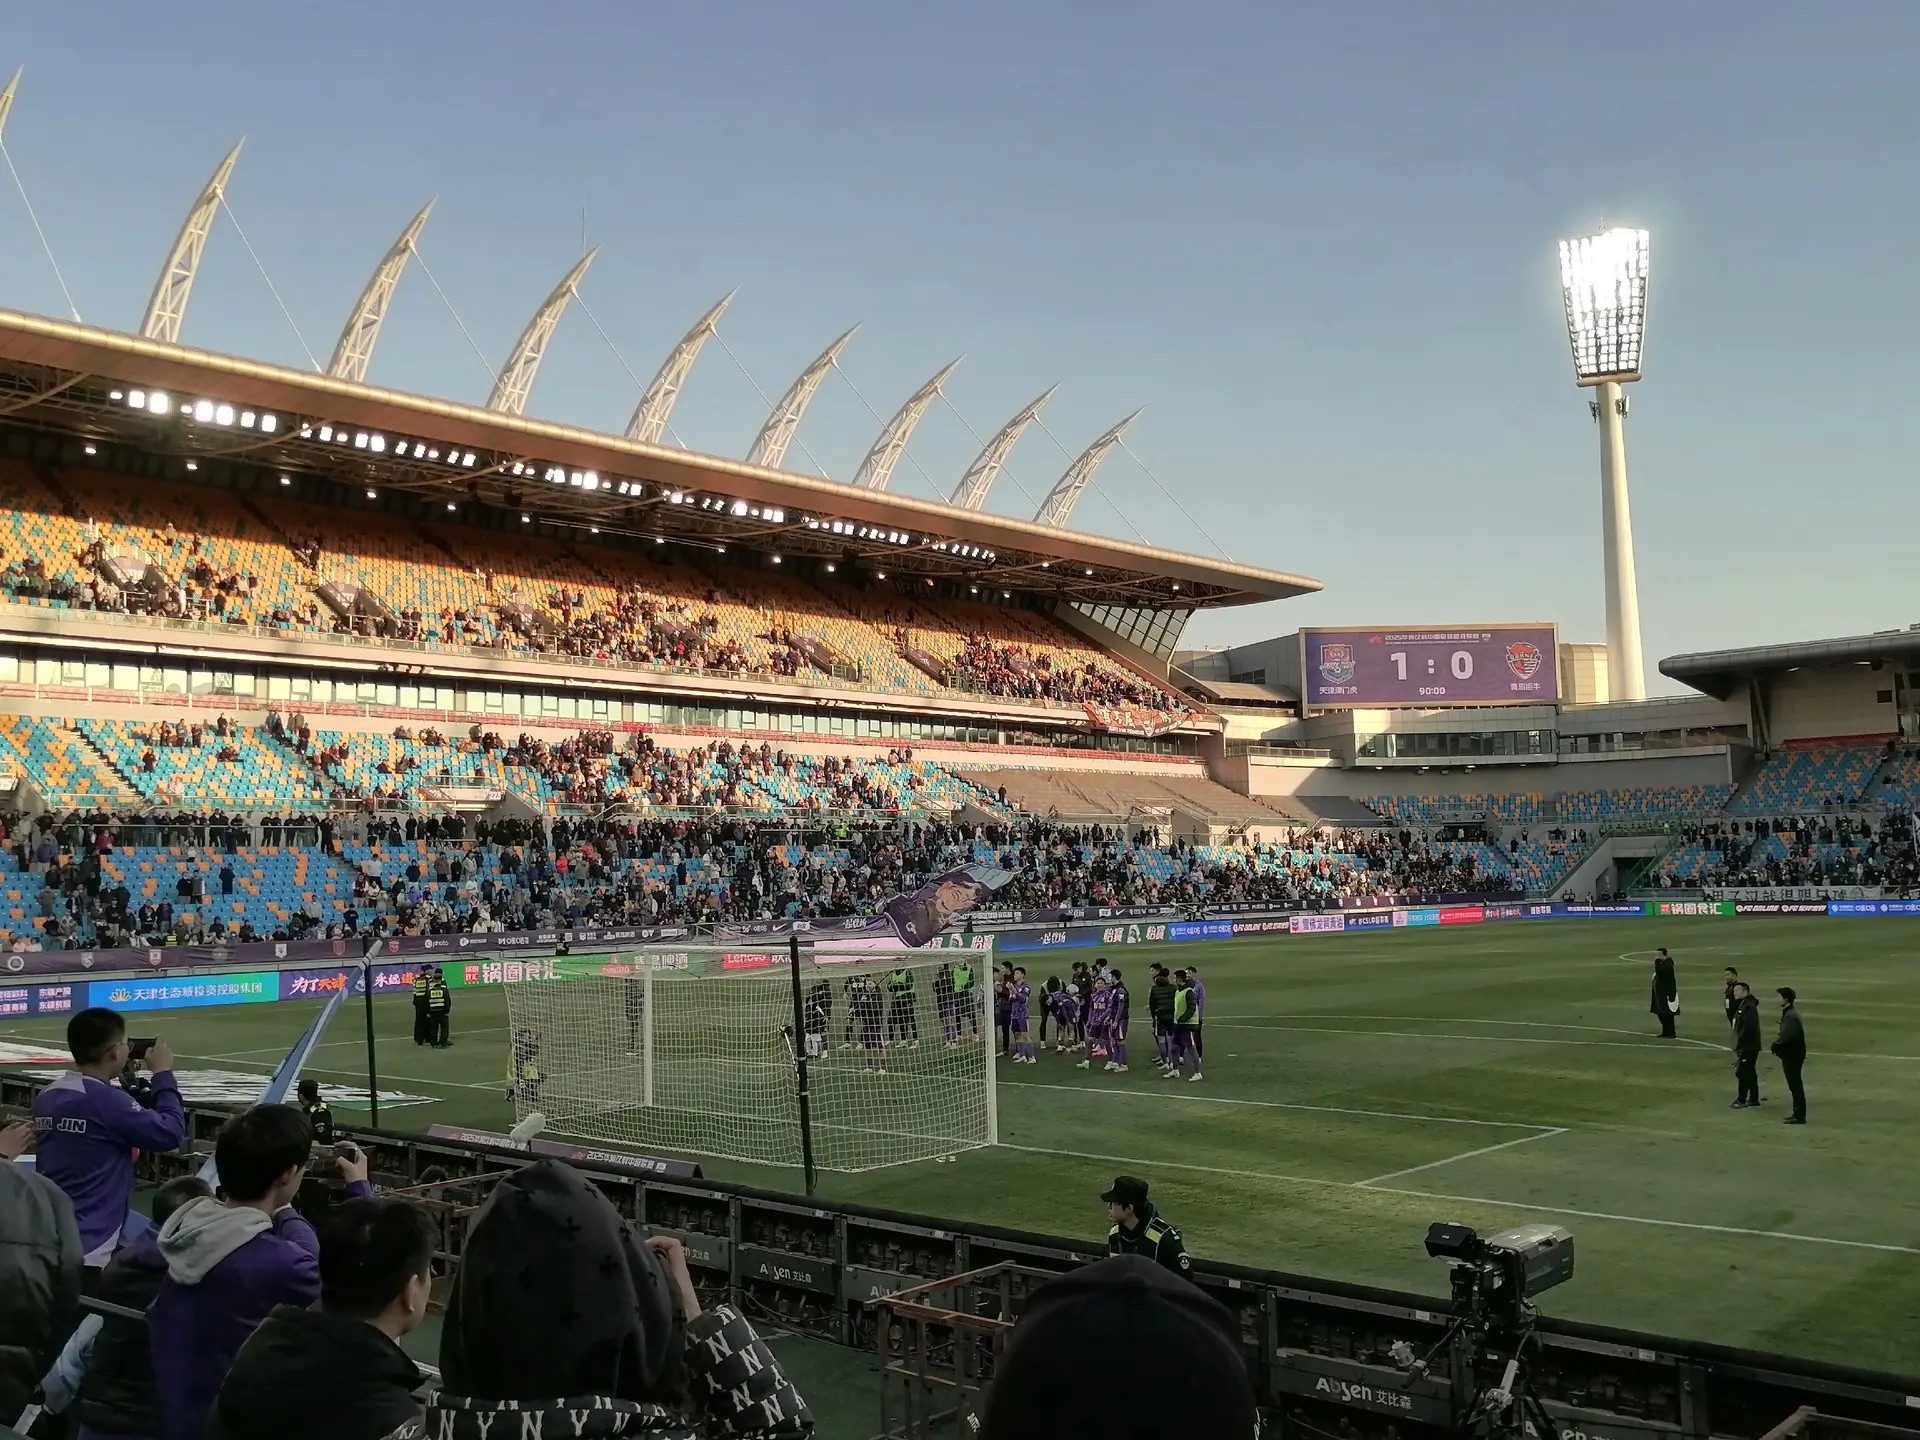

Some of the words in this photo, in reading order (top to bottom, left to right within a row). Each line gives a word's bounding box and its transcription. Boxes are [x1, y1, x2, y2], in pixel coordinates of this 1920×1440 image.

[1390, 652, 1408, 680] 1
[1451, 650, 1474, 680] 0
[1418, 687, 1446, 696] 90:00
[56, 1117, 87, 1134] JIN
[1315, 1377, 1372, 1402] Absen
[1375, 1389, 1413, 1410] 艾比森
